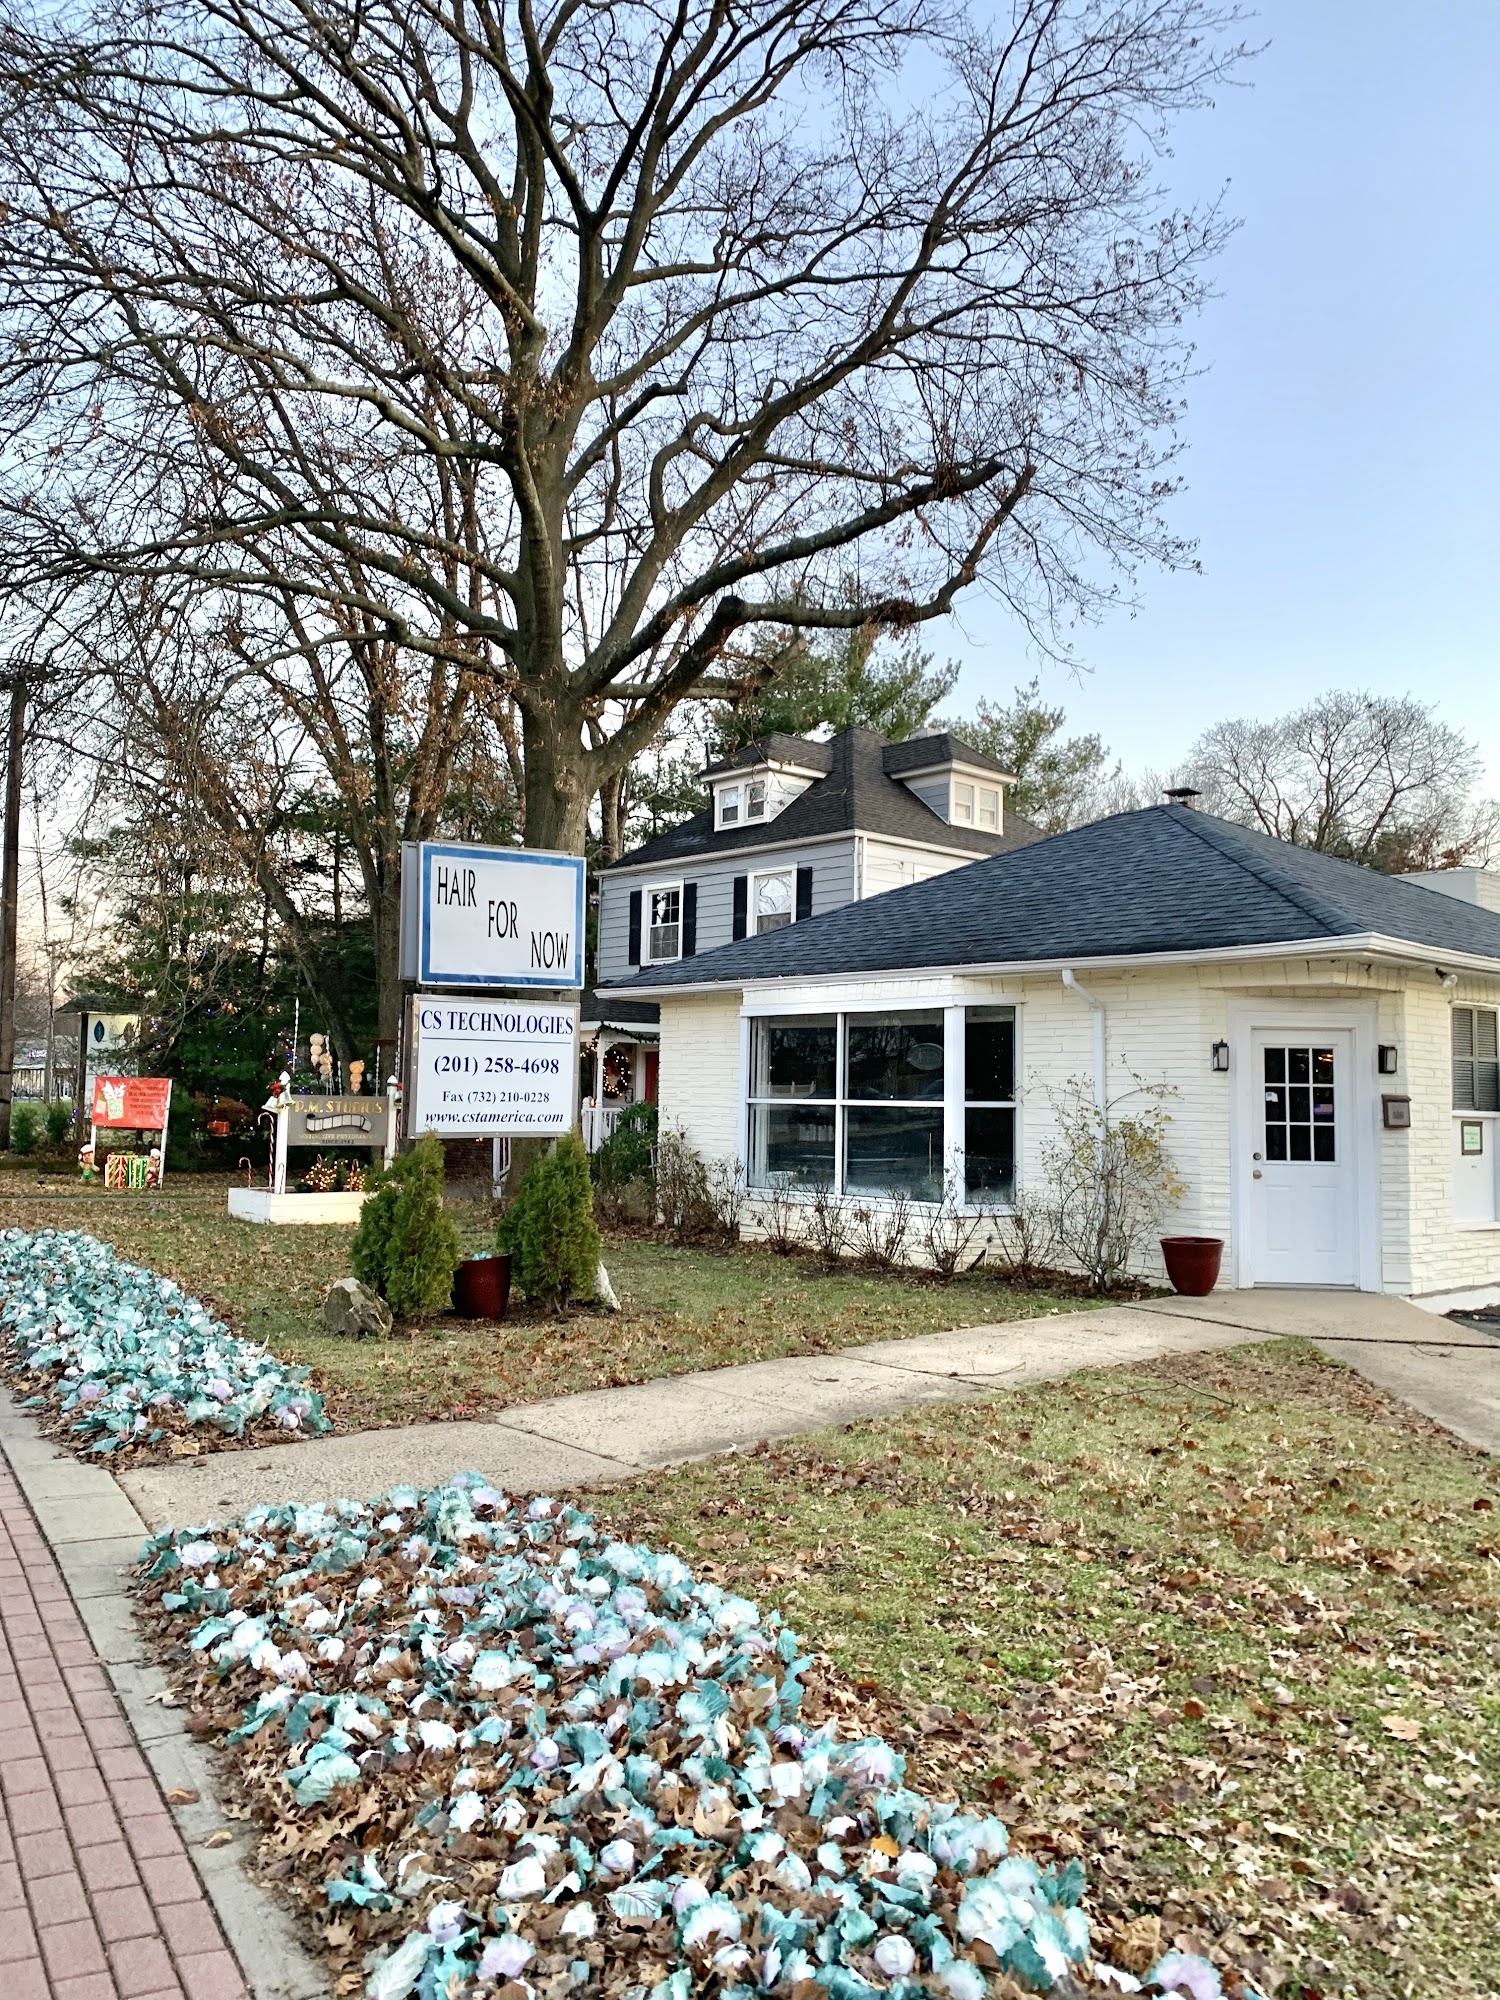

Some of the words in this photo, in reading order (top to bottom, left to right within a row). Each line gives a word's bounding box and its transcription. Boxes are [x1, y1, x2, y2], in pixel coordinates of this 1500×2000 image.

[437, 866, 477, 907] HAIR
[488, 900, 518, 938] FOR
[531, 931, 569, 969] NOW
[421, 1009, 442, 1030] CS
[447, 1011, 573, 1035] TECHNOLOGIES
[434, 1055, 478, 1076] (201)
[484, 1056, 560, 1075] 258-4698
[294, 1100, 323, 1113] P.M.
[442, 1090, 464, 1103] Fax
[467, 1091, 497, 1105] (732)
[500, 1091, 550, 1104] 210-0228
[425, 1109, 564, 1124] www.cstamerica.com
